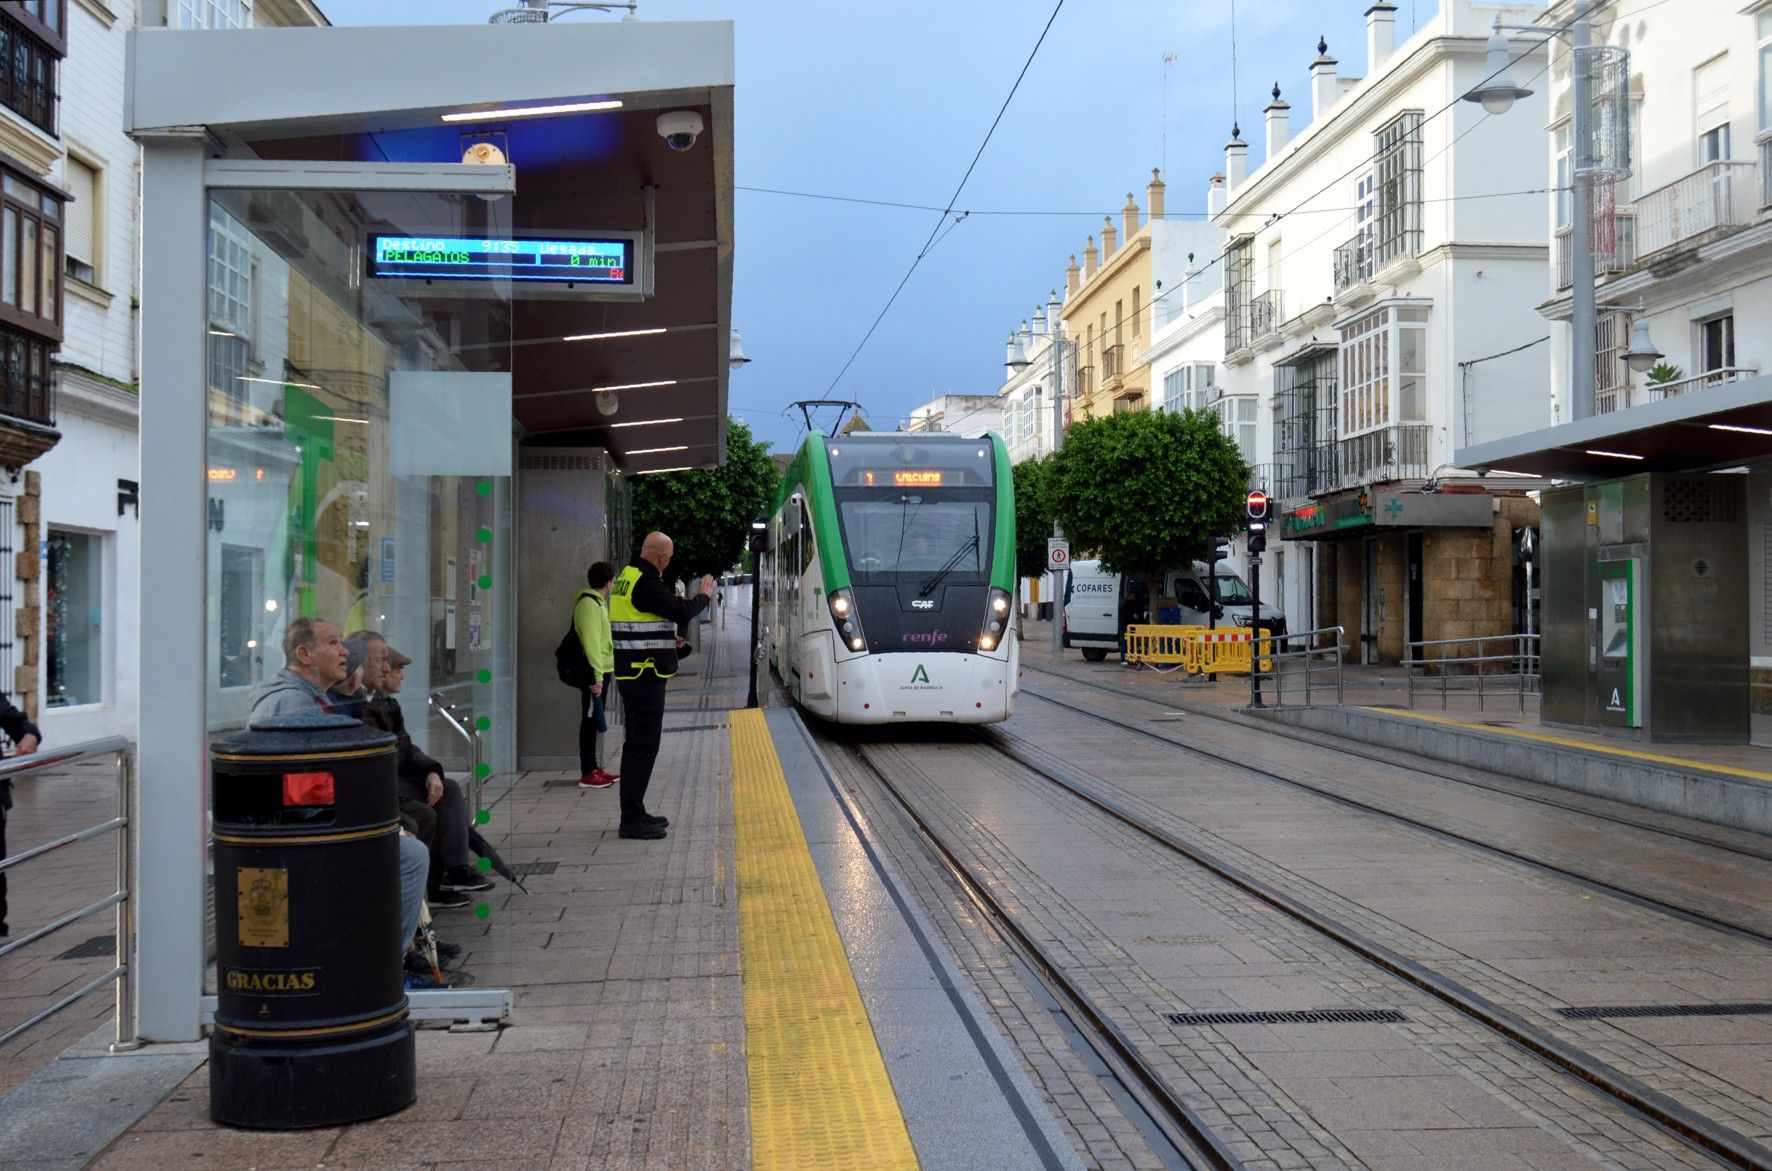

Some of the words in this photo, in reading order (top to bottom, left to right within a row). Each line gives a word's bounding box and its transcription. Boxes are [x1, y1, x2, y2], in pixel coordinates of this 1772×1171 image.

[382, 239, 445, 251] Destino
[481, 240, 520, 253] 9:35
[385, 250, 470, 263] PELAGATOS
[589, 256, 617, 267] min
[1076, 583, 1113, 593] COFARES
[911, 600, 934, 609] CAF
[902, 629, 949, 647] renfe
[227, 971, 315, 990] GRACIAS
